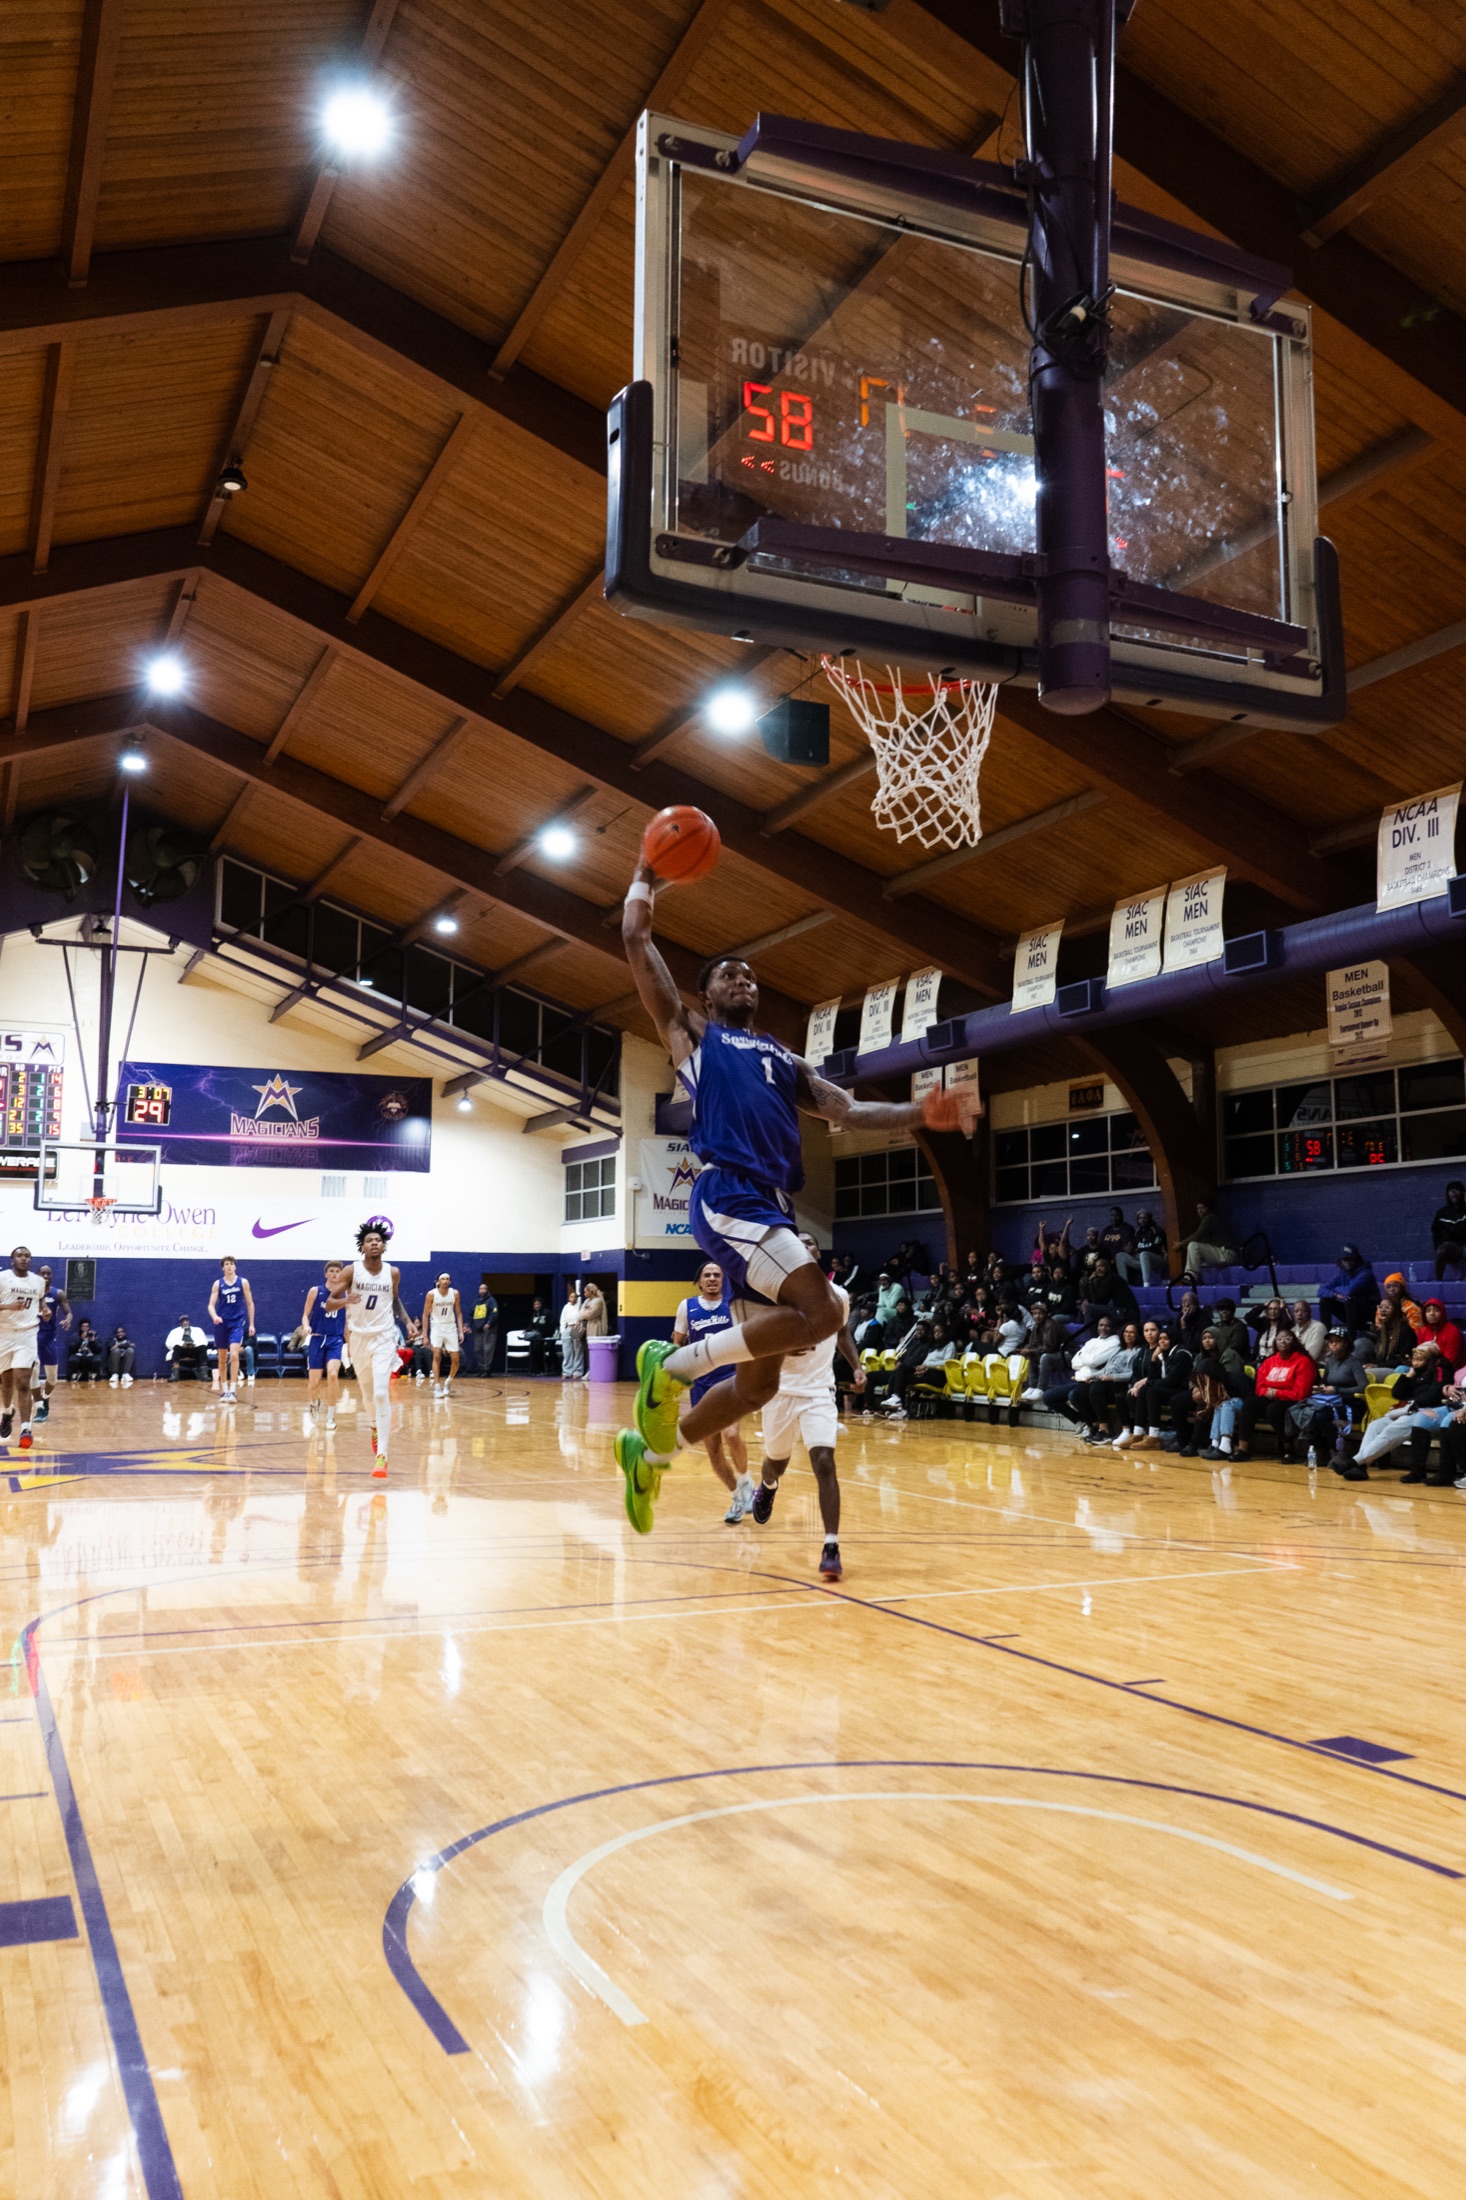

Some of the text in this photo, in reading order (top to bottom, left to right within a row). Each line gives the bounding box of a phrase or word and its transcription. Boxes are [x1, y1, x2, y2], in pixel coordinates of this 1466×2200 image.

[1393, 796, 1438, 826] NCAA
[1392, 817, 1439, 849] DIV. III
[1409, 851, 1421, 862] MEN
[1184, 881, 1209, 902] SIAC
[1126, 900, 1150, 920] SIAC
[1183, 899, 1208, 922] MEN
[1125, 919, 1148, 940] MEN
[1029, 933, 1048, 952] SIAC
[1028, 951, 1047, 970] MEN
[1345, 968, 1369, 983] MEN
[915, 987, 931, 1004] MEN
[1332, 981, 1384, 1001] Basketball
[762, 1056, 777, 1085] 1
[956, 1063, 969, 1072] MEN
[19, 1072, 26, 1083] 2
[52, 1073, 62, 1085] 14
[18, 1084, 26, 1096] 3
[37, 1085, 44, 1097] 2
[138, 1086, 170, 1100] 3:07
[14, 1096, 25, 1109] 12
[9, 1109, 24, 1121] 21
[35, 1110, 43, 1122] 2
[134, 1100, 163, 1124] 29
[9, 1122, 24, 1134] 35
[49, 1124, 60, 1135] 15
[230, 1112, 320, 1139] MAGICIANS
[666, 1142, 690, 1152] SIA
[118, 1226, 217, 1240] COLLEGE
[665, 1223, 690, 1235] NCA
[355, 1283, 390, 1293] MAGICIANS
[227, 1294, 236, 1304] 12
[365, 1295, 378, 1310] 0
[441, 1307, 448, 1316] 11
